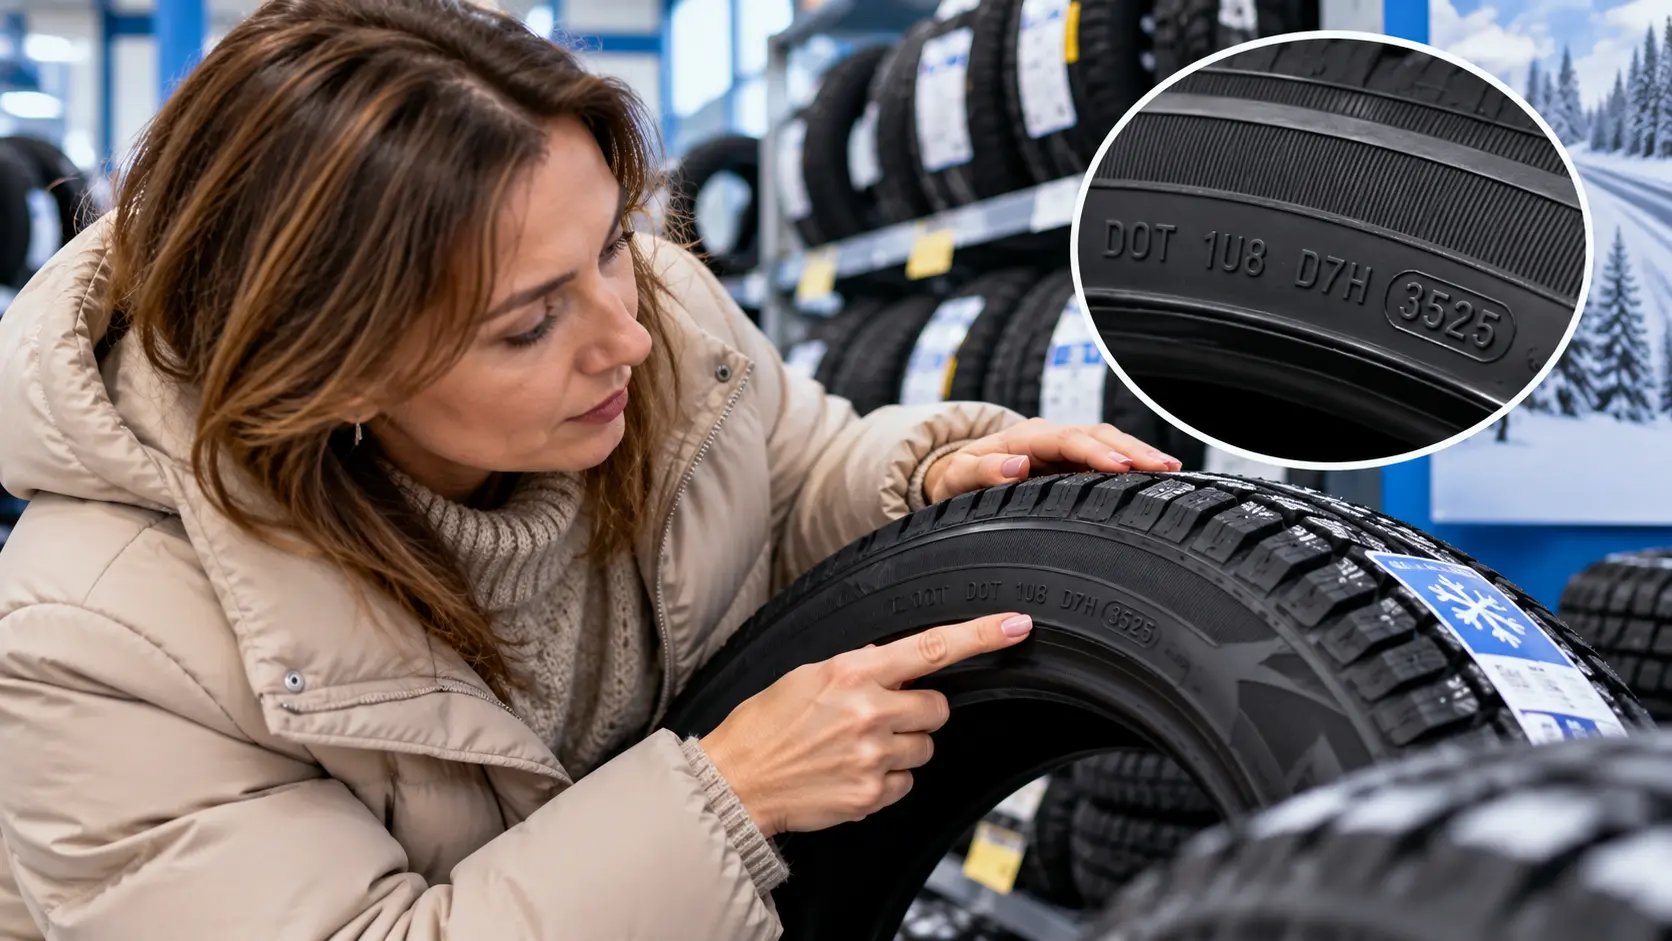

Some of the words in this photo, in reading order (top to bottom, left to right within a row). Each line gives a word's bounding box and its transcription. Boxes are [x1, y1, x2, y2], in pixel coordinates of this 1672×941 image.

[1102, 219, 1177, 262] DOT
[1204, 230, 1267, 276] 1U8
[1294, 248, 1373, 304] D7H
[1398, 281, 1501, 348] 3525
[966, 581, 1002, 602] DOT
[1016, 582, 1048, 604] 1U8
[1060, 588, 1099, 616] D7H
[1108, 603, 1156, 642] 3525
